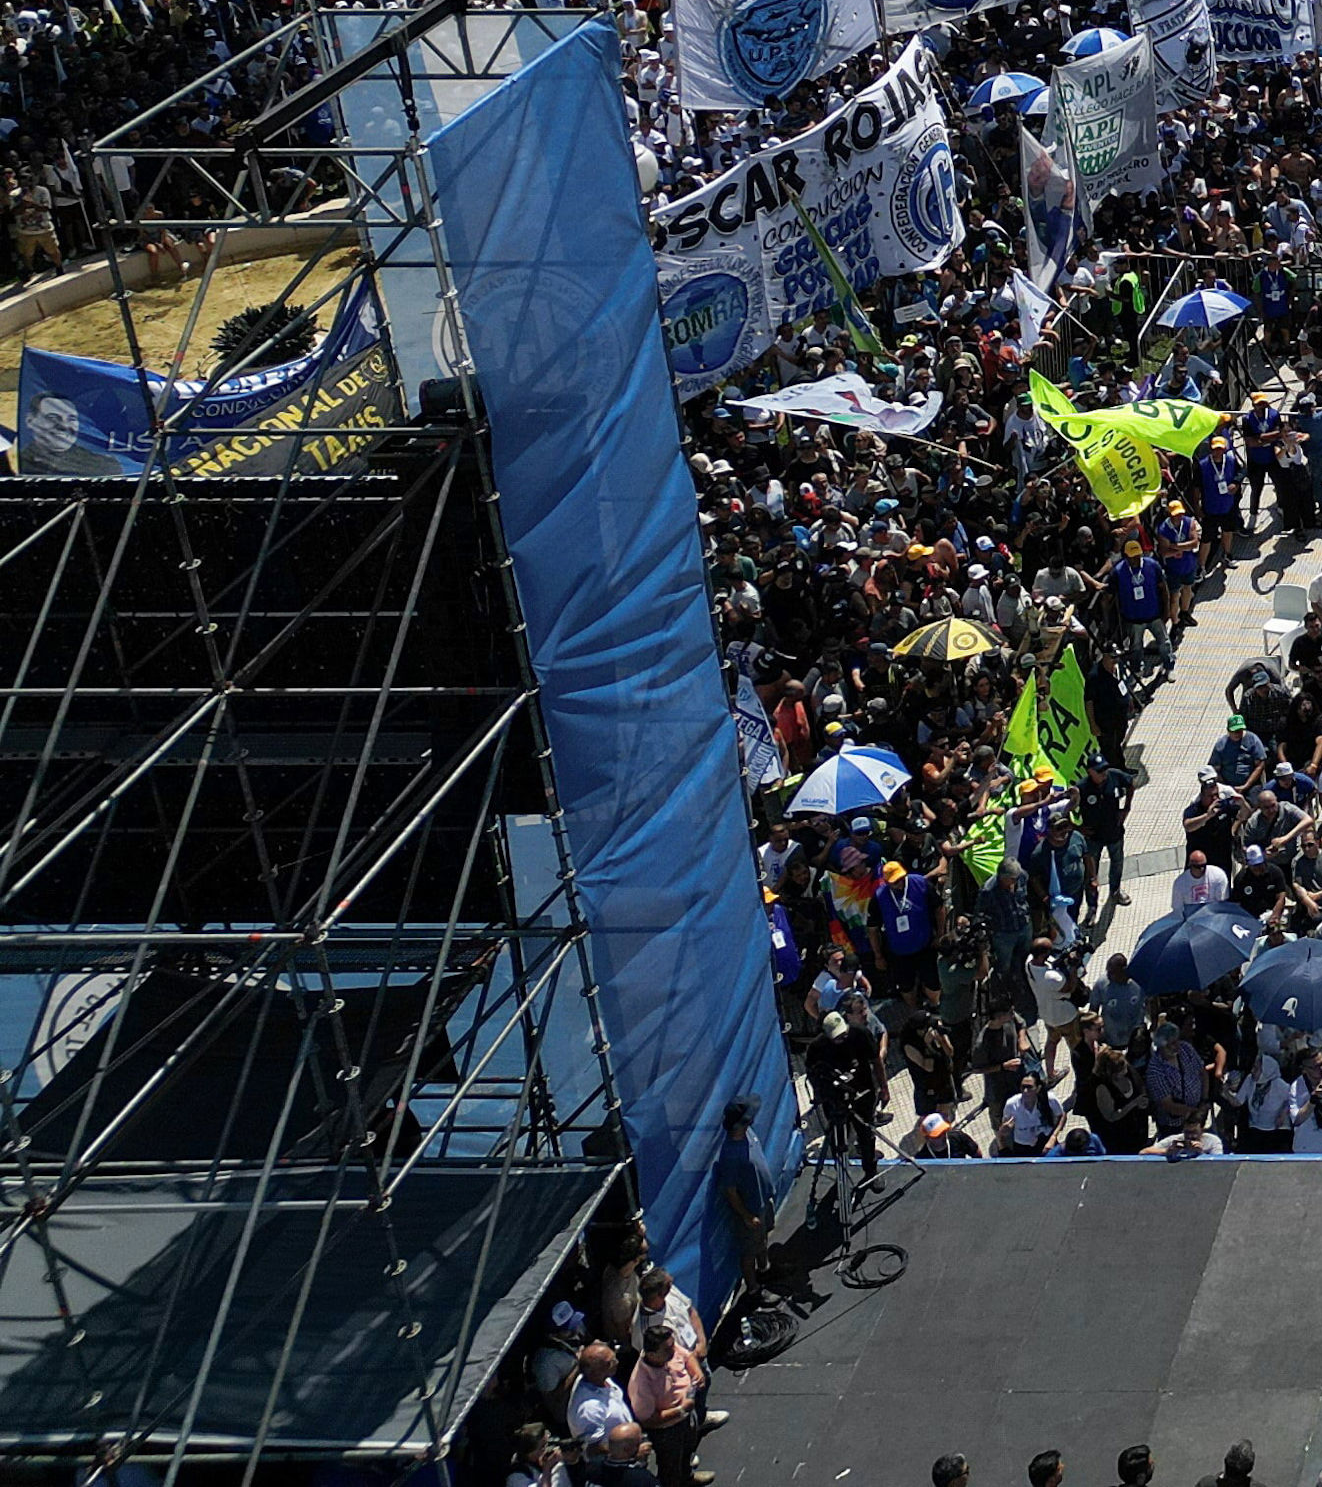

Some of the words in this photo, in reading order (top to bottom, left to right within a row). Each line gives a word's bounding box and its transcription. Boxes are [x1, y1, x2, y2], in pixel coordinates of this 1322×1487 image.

[1082, 75, 1117, 101] APL
[1080, 120, 1119, 143] APL
[194, 388, 343, 477] NACIONAL
[336, 370, 370, 398] DE
[302, 405, 386, 471] TAXIS
[1114, 436, 1149, 492] UOCRA
